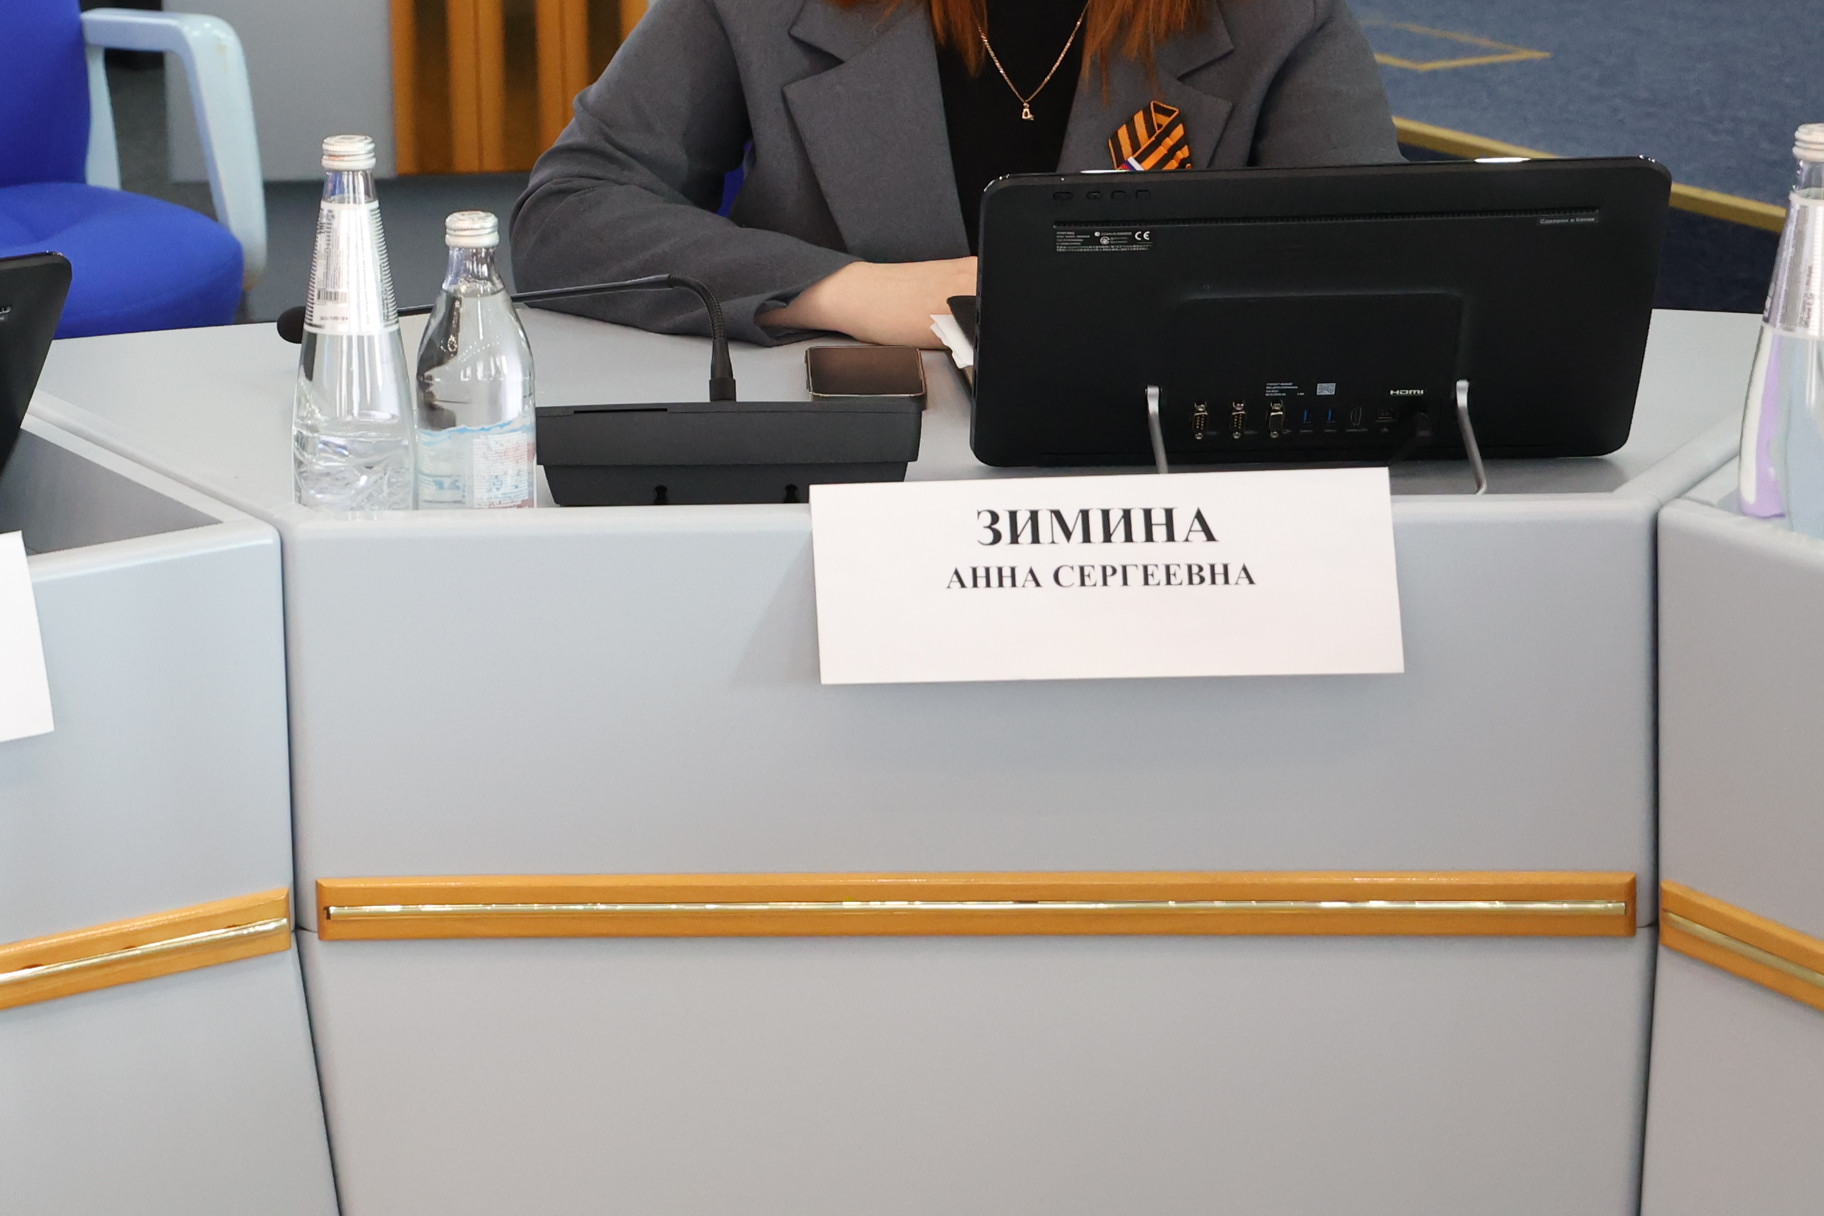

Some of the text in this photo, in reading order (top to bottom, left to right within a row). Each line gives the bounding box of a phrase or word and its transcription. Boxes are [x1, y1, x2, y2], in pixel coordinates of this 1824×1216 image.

[1134, 230, 1151, 241] CE
[976, 507, 1219, 546] ЗИМИНА
[946, 563, 1257, 589] АННА СЕРГЕЕВНА
